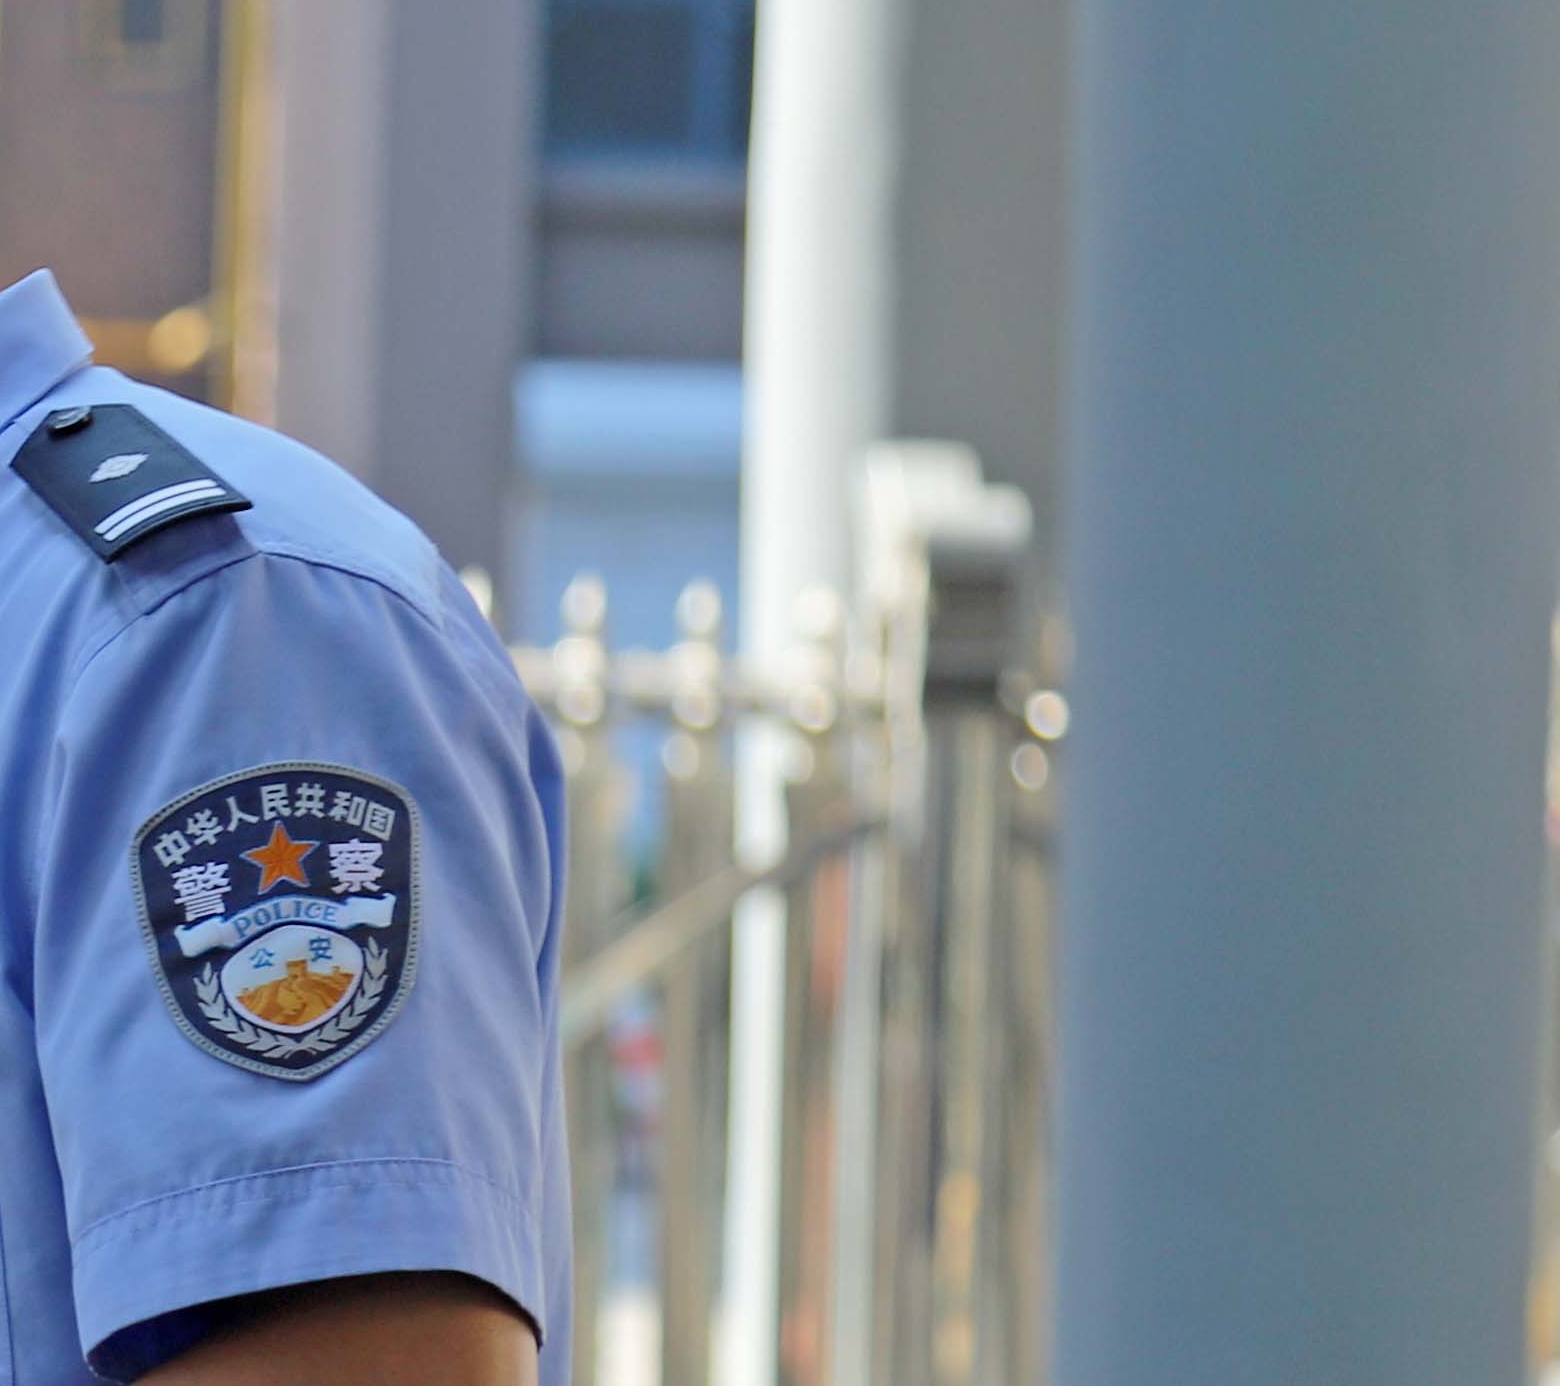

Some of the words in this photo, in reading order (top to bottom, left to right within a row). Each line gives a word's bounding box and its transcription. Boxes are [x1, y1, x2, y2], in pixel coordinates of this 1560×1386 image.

[153, 783, 396, 867] 中华人民共和国
[232, 897, 339, 940] POLICE
